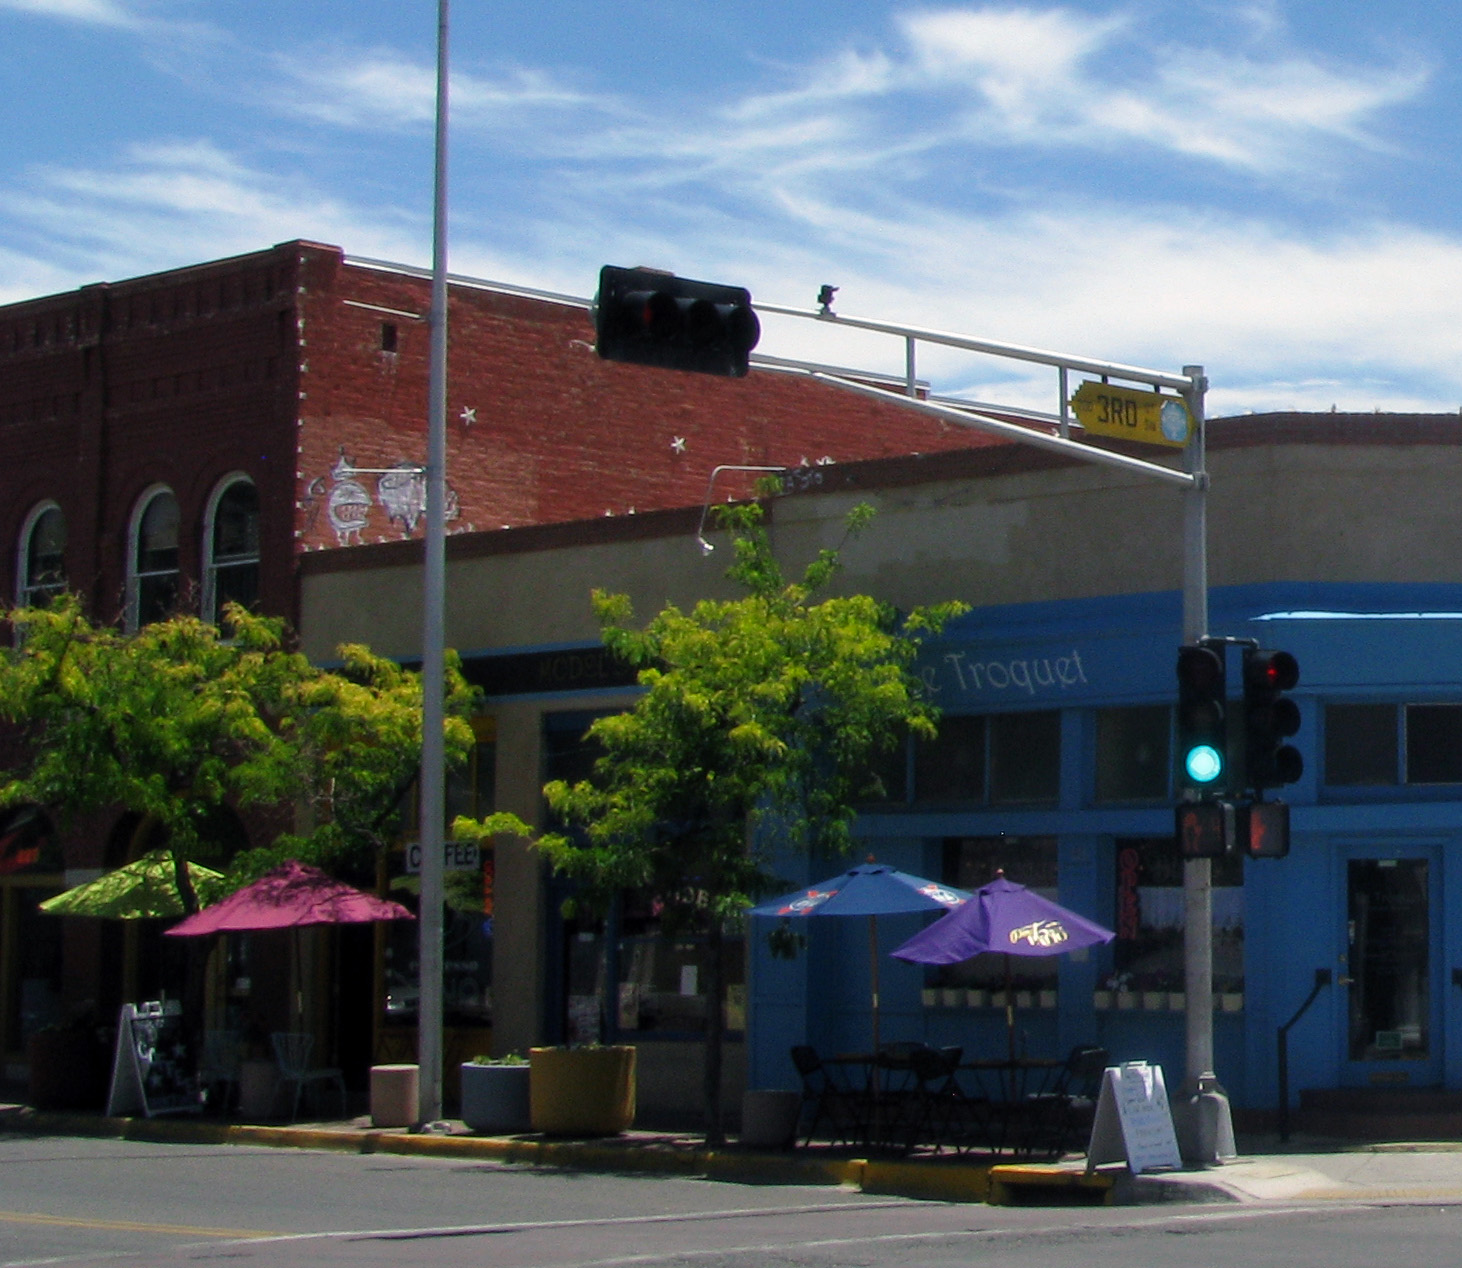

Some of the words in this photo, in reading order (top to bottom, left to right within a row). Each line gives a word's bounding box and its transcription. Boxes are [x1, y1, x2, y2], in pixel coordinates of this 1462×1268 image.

[1097, 395, 1137, 427] 3RD
[943, 649, 1088, 695] Troquet
[410, 843, 474, 868] CFEE
